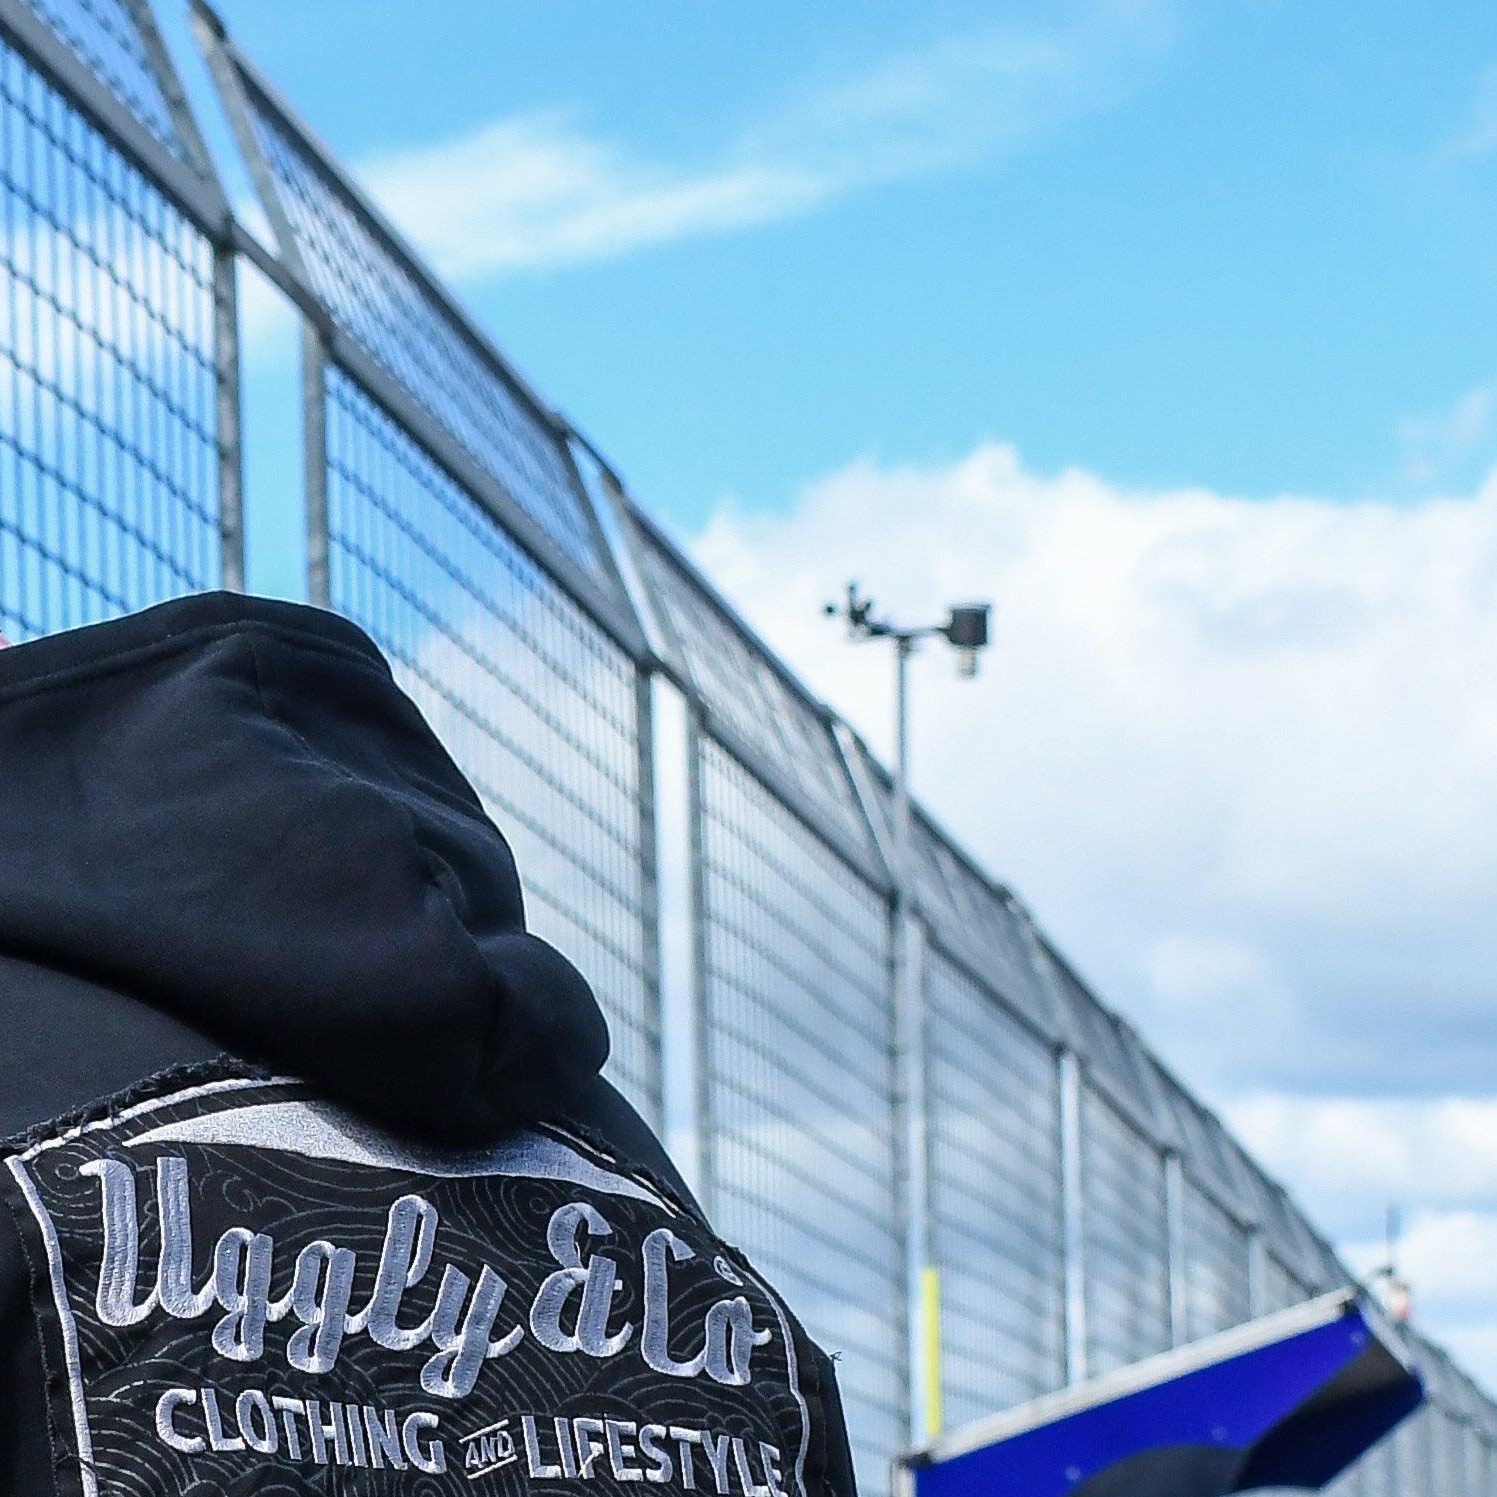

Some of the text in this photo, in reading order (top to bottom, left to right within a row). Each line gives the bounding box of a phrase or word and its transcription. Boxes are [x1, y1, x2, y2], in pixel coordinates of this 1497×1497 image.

[78, 1156, 526, 1399] Uggly
[155, 1386, 448, 1475] CLOTHING
[462, 1426, 517, 1473] AND
